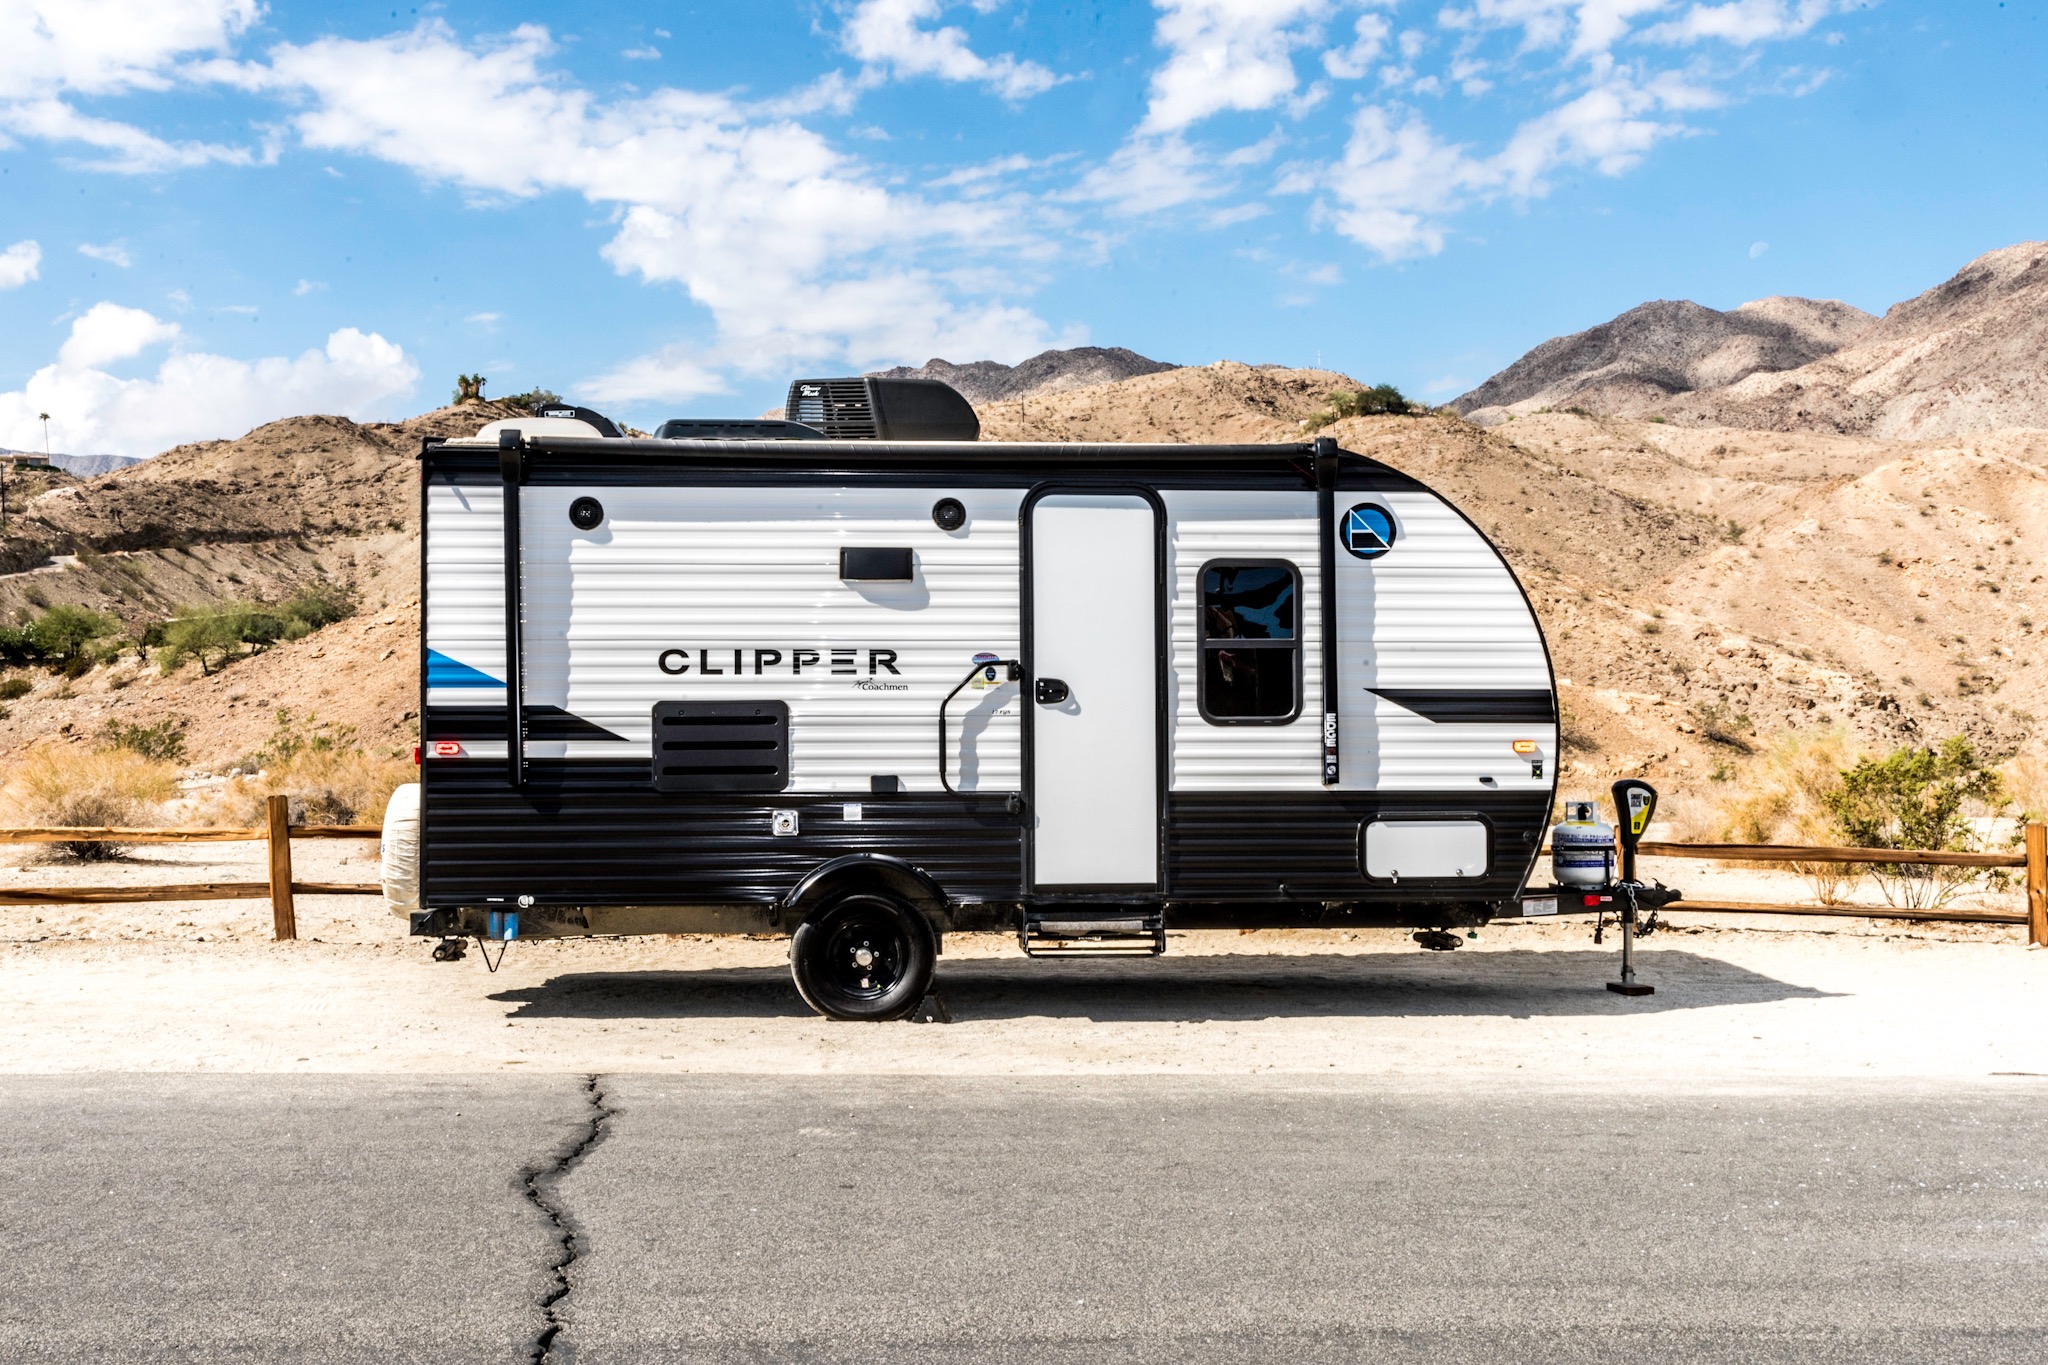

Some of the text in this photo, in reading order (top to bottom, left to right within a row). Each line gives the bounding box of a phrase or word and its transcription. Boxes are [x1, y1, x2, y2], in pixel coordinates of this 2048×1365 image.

[658, 649, 902, 675] CLIPPER
[862, 683, 909, 691] Coachmen
[1326, 713, 1337, 747] EDGE
